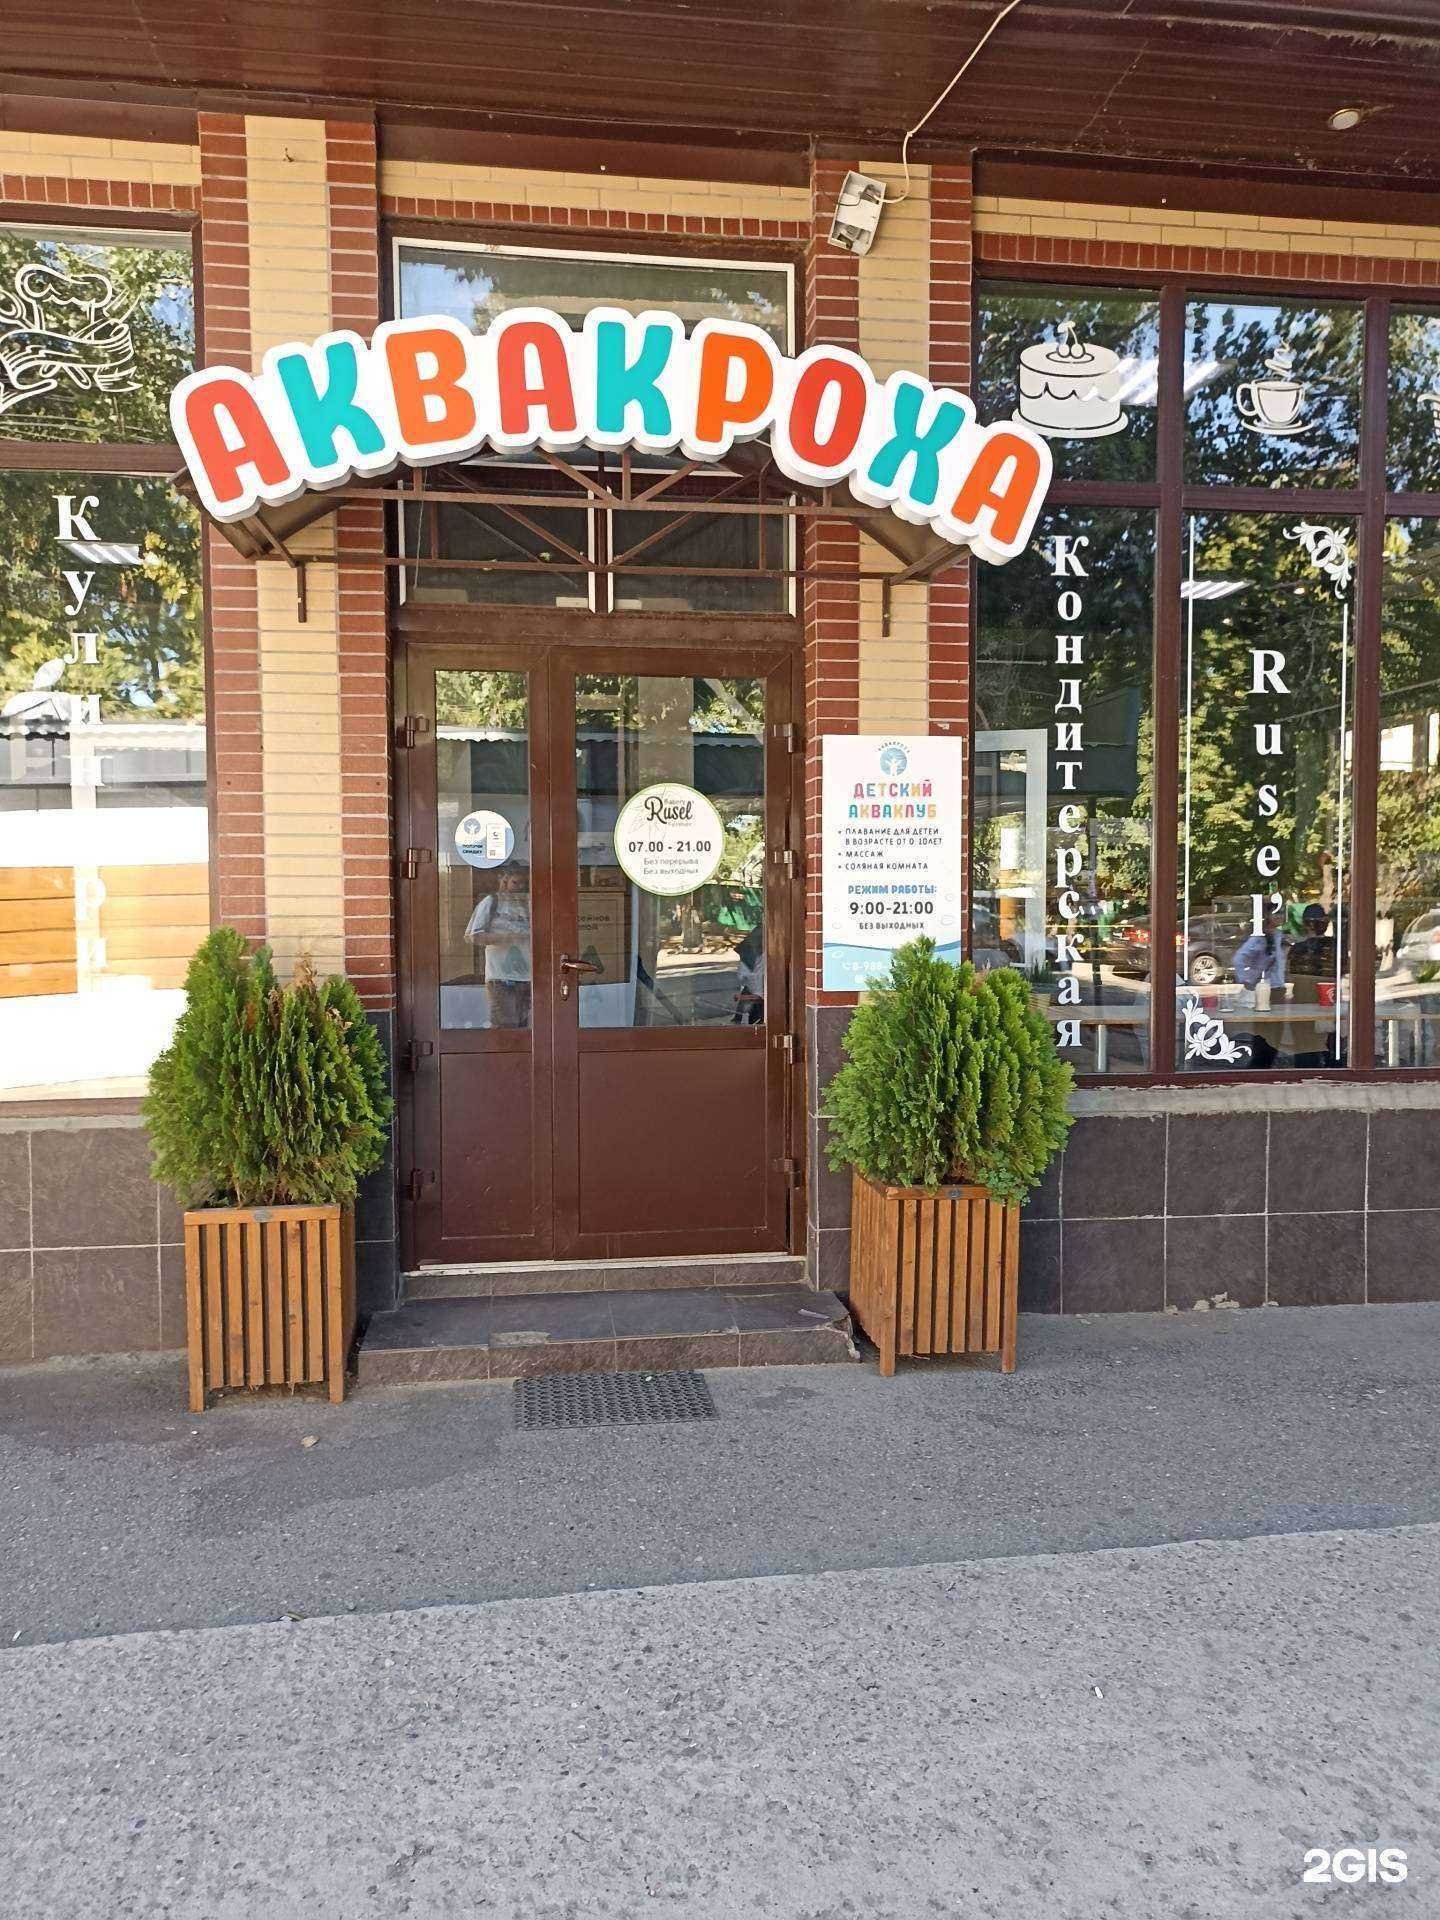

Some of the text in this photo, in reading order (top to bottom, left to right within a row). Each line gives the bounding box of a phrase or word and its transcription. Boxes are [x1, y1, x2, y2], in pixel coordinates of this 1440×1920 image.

[185, 320, 1042, 546] АКВАКРОХА
[853, 779, 933, 799] ДЕТСКИЙ
[1050, 535, 1090, 1048] Кондитерская
[848, 804, 937, 818] АКВАКЛУБ
[845, 827, 891, 835] ПЛАВАНИЕ
[893, 827, 910, 836] ДЛЯ
[628, 841, 664, 852] 07.00
[677, 840, 712, 852] 21.00
[845, 850, 884, 858] МАССАЖ
[660, 858, 699, 867] перерыва
[643, 867, 699, 875] Без выходных
[848, 884, 937, 894] РЕЖИМ РАБОТЫ:
[849, 901, 934, 915] 9:00-21:00
[876, 922, 924, 930] ВЫХОДНЫХ
